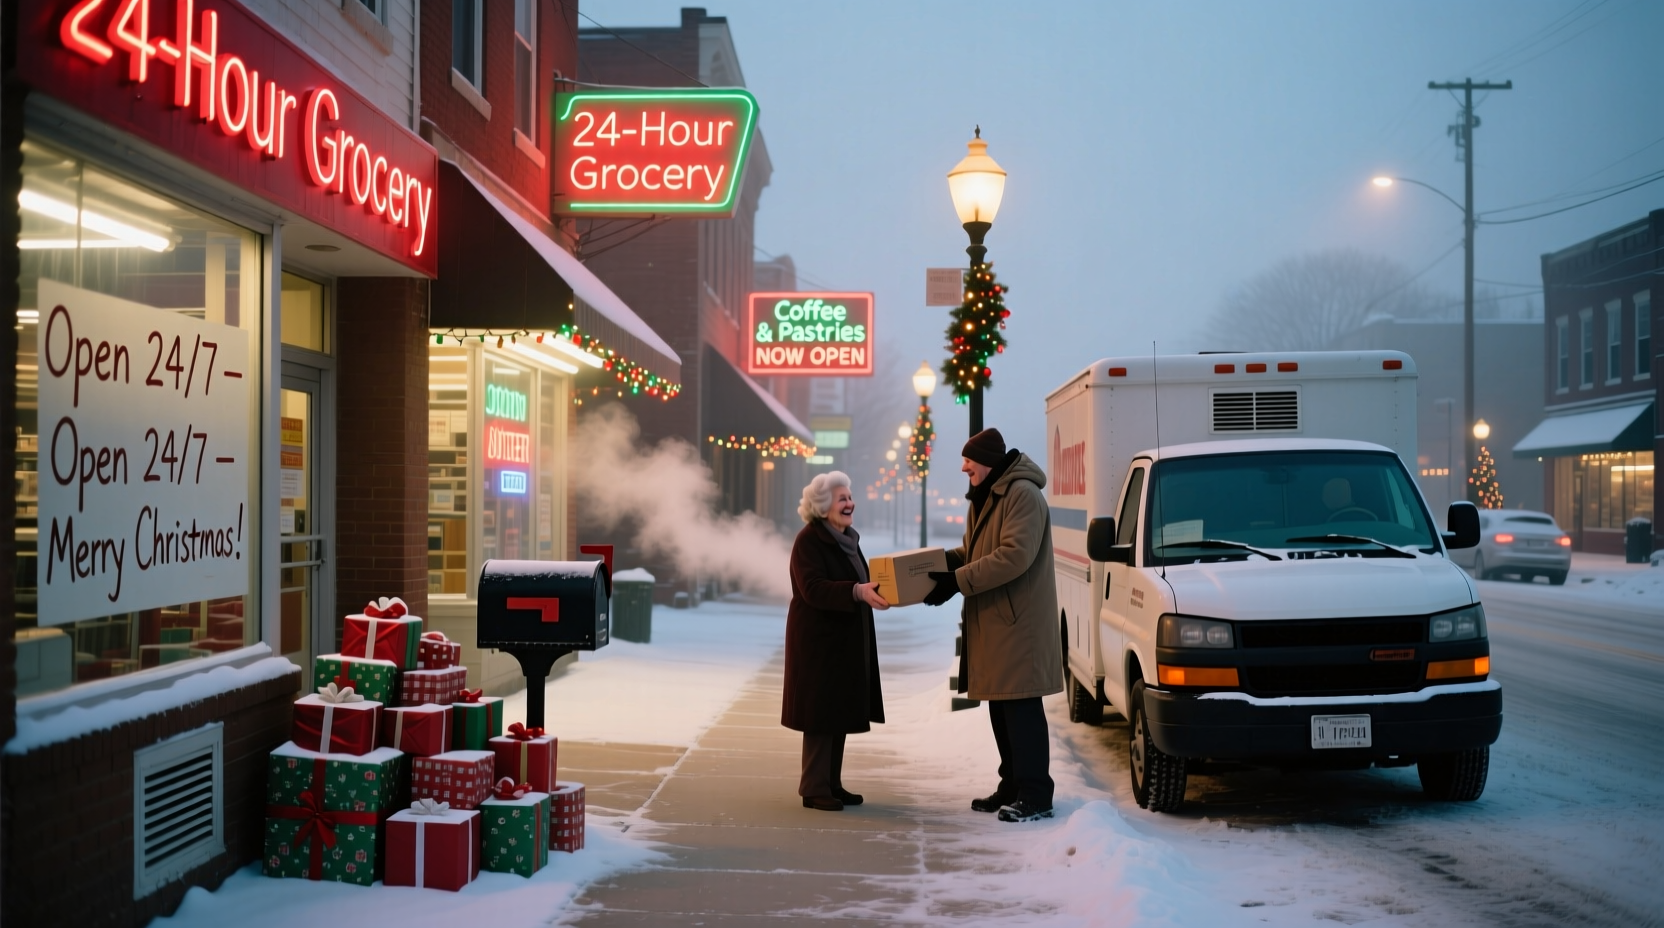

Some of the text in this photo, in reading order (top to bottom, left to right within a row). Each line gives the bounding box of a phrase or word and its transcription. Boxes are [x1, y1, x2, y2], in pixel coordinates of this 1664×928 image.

[572, 111, 734, 146] 24-Hour
[306, 88, 433, 256] Grocery
[570, 156, 725, 201] Grocery
[756, 322, 866, 342] & Pastries
[774, 299, 847, 321] Coffee
[45, 305, 129, 408] Open
[756, 347, 865, 366] NOW OPEN
[51, 417, 127, 512] Open
[47, 503, 243, 602] Merry Christmas!
